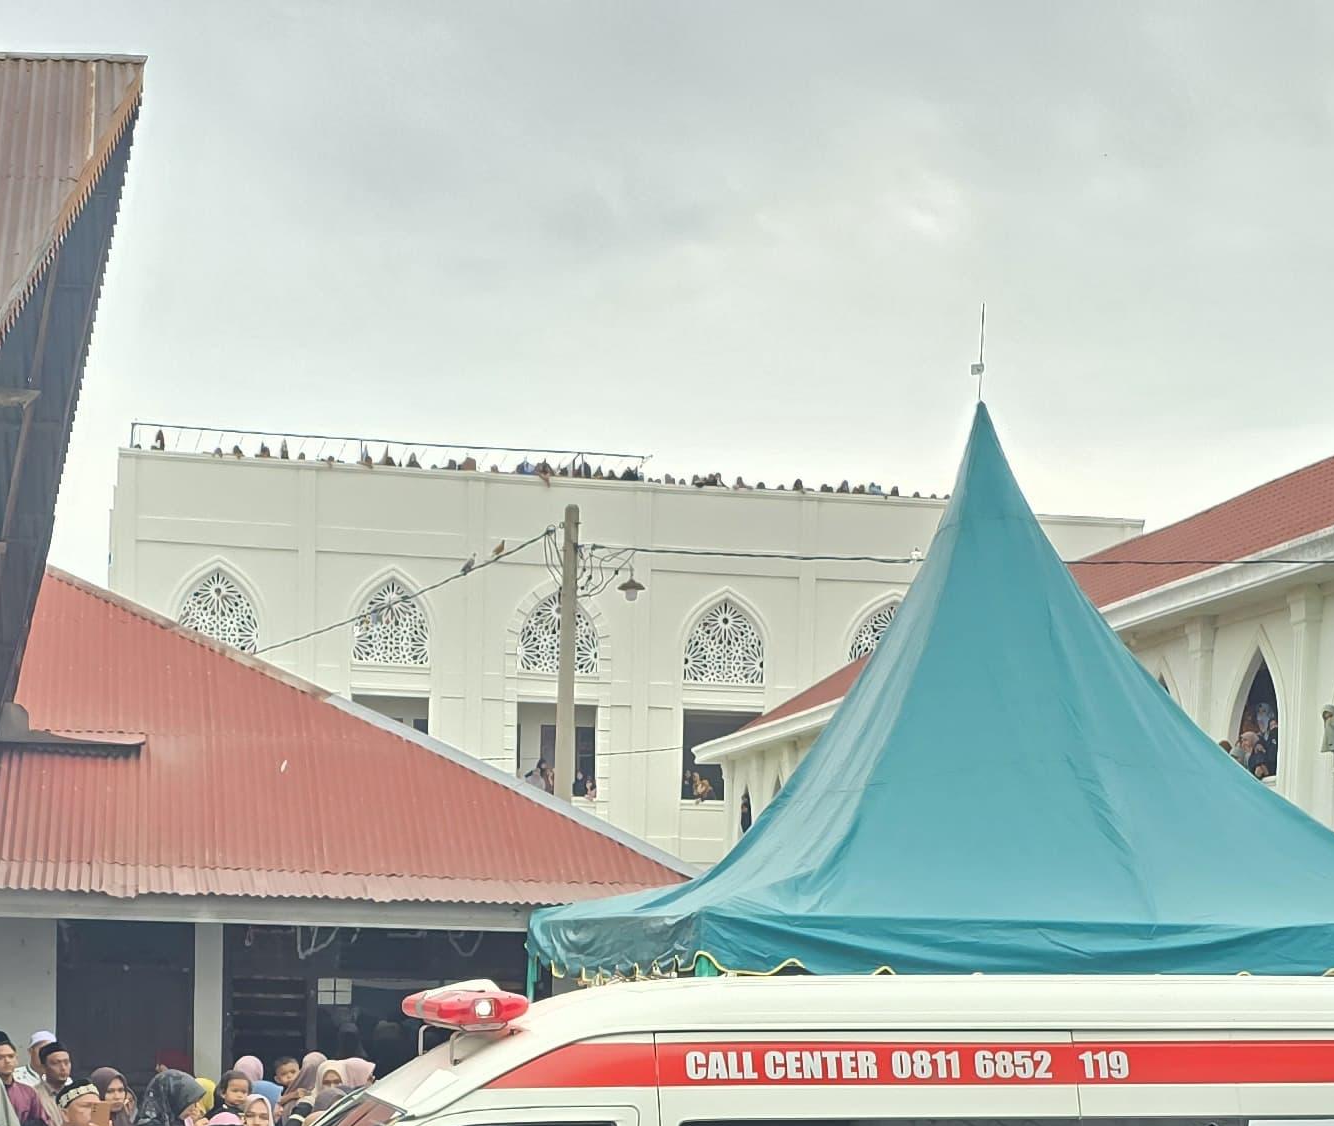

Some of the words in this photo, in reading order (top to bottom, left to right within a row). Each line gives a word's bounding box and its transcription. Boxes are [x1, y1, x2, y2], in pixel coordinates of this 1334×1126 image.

[685, 1051, 758, 1079] CALL
[764, 1051, 877, 1079] CENTER
[891, 1050, 960, 1079] 0811
[974, 1050, 1053, 1079] 6852
[1078, 1050, 1129, 1079] 119
